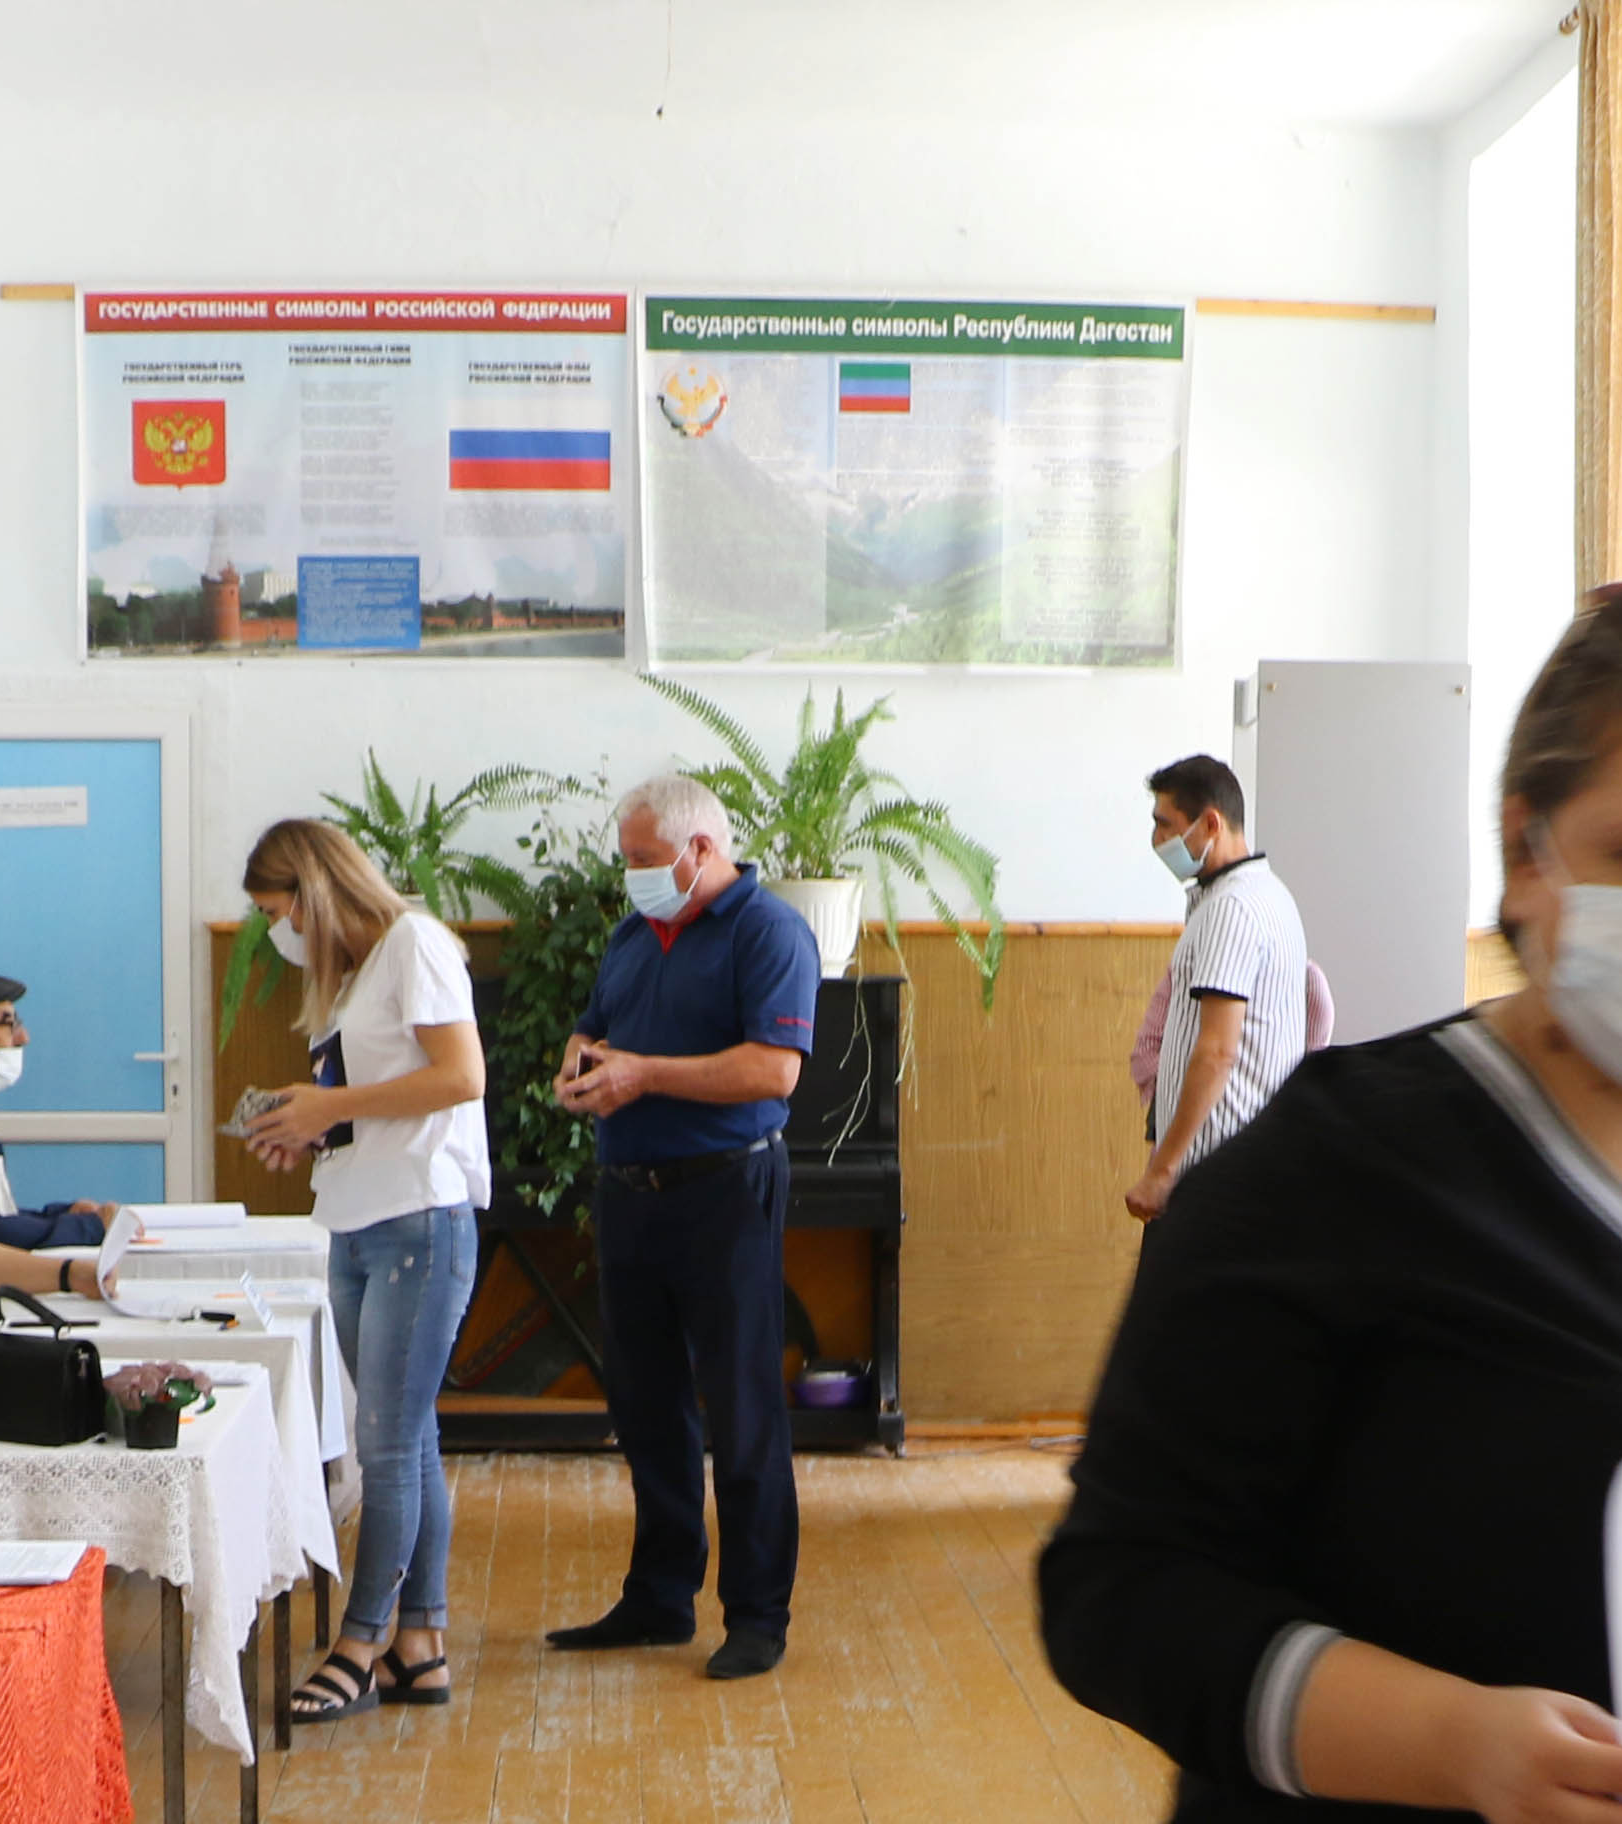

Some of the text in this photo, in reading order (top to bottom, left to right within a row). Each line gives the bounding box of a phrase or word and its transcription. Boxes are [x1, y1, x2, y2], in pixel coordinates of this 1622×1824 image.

[98, 298, 611, 321] ГОСУДАРСТВЕННЫЕ СИМВОЛЫ РОССИЙСКОЙ ФЕДЕРАЦИИ
[662, 310, 1173, 344] Государственные символы Республики Дагестан
[288, 343, 383, 354] ГОСУДАРСТВЕННЫЙ
[123, 361, 218, 372] ГОСУДАРСТВЕННЫЙ
[288, 356, 412, 367] РОССИЙСКОЙ ФЕДЕРАЦИИ
[468, 361, 563, 372] ГОСУДАРСТВЕННЫЙ
[122, 373, 245, 384] РОССИЙСКОЙ ФЕДЕРАЦИИ
[468, 373, 592, 384] РОССИЙСКОЙ ФЕДЕРАЦИИ
